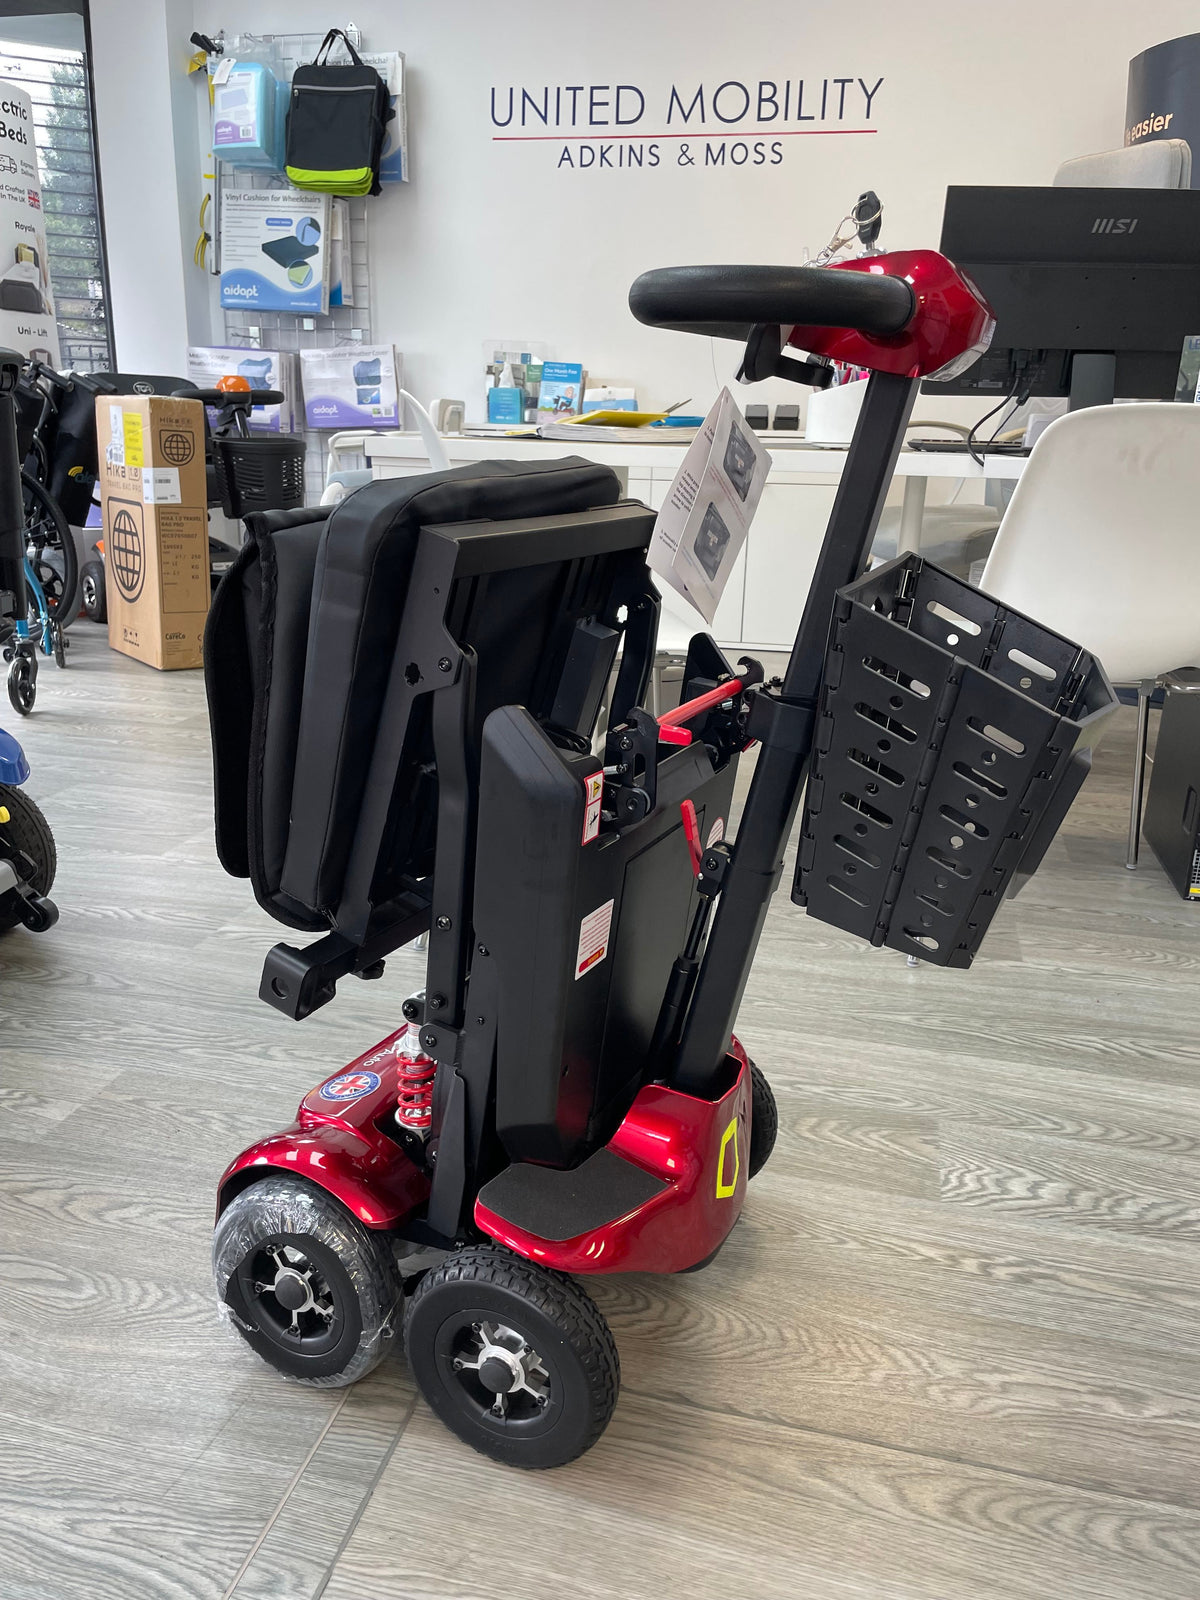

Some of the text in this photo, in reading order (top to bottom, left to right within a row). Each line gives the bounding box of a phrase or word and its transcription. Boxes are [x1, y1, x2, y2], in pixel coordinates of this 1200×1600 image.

[491, 78, 884, 127] UNITED MOBILITY
[0, 100, 28, 121] ctric
[0, 121, 28, 145] Beds
[1131, 112, 1174, 142] easier
[557, 142, 784, 169] ADKINS & MOSS
[8, 193, 18, 202] The
[225, 193, 322, 204] Vinyl Cushion for Wheelchairs
[15, 221, 35, 233] Royale
[223, 284, 260, 299] aidapt
[18, 326, 32, 335] Uni
[312, 404, 339, 415] aidapt
[165, 632, 186, 641] CareCo
